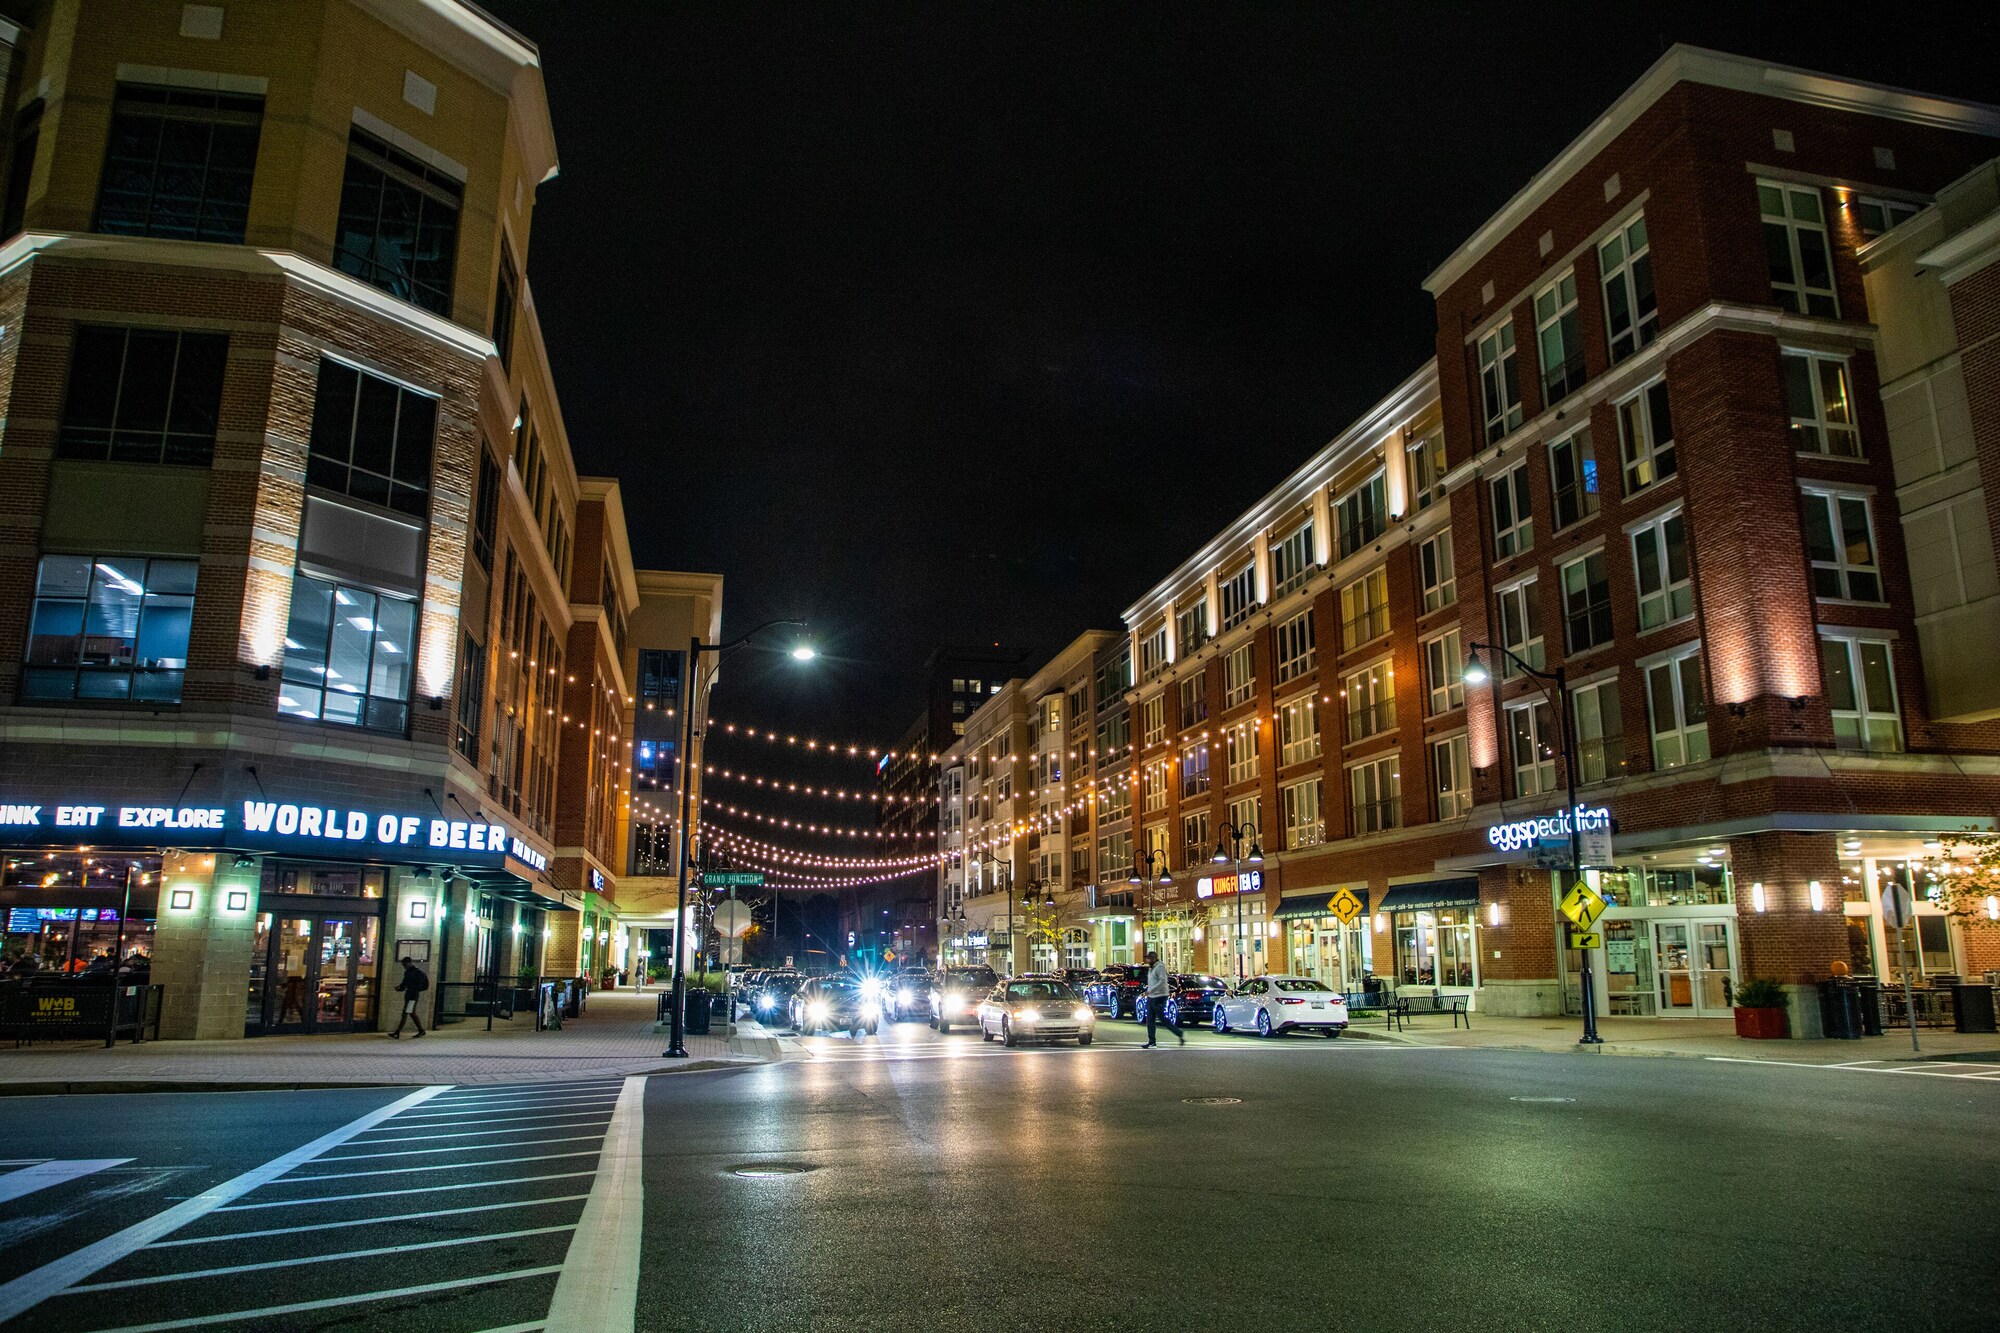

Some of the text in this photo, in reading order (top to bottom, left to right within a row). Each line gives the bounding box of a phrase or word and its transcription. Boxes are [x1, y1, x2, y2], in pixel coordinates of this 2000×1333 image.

[0, 805, 225, 829] INK EAT EXPLORE
[243, 800, 506, 852] WORLD OF BEER
[1488, 803, 1610, 852] eggspectation
[704, 874, 726, 884] GRAND
[727, 874, 758, 884] JUNCTION
[1213, 877, 1231, 895] KUNG
[1231, 875, 1239, 892] FU
[1239, 873, 1252, 891] TEA
[1147, 932, 1157, 940] 15
